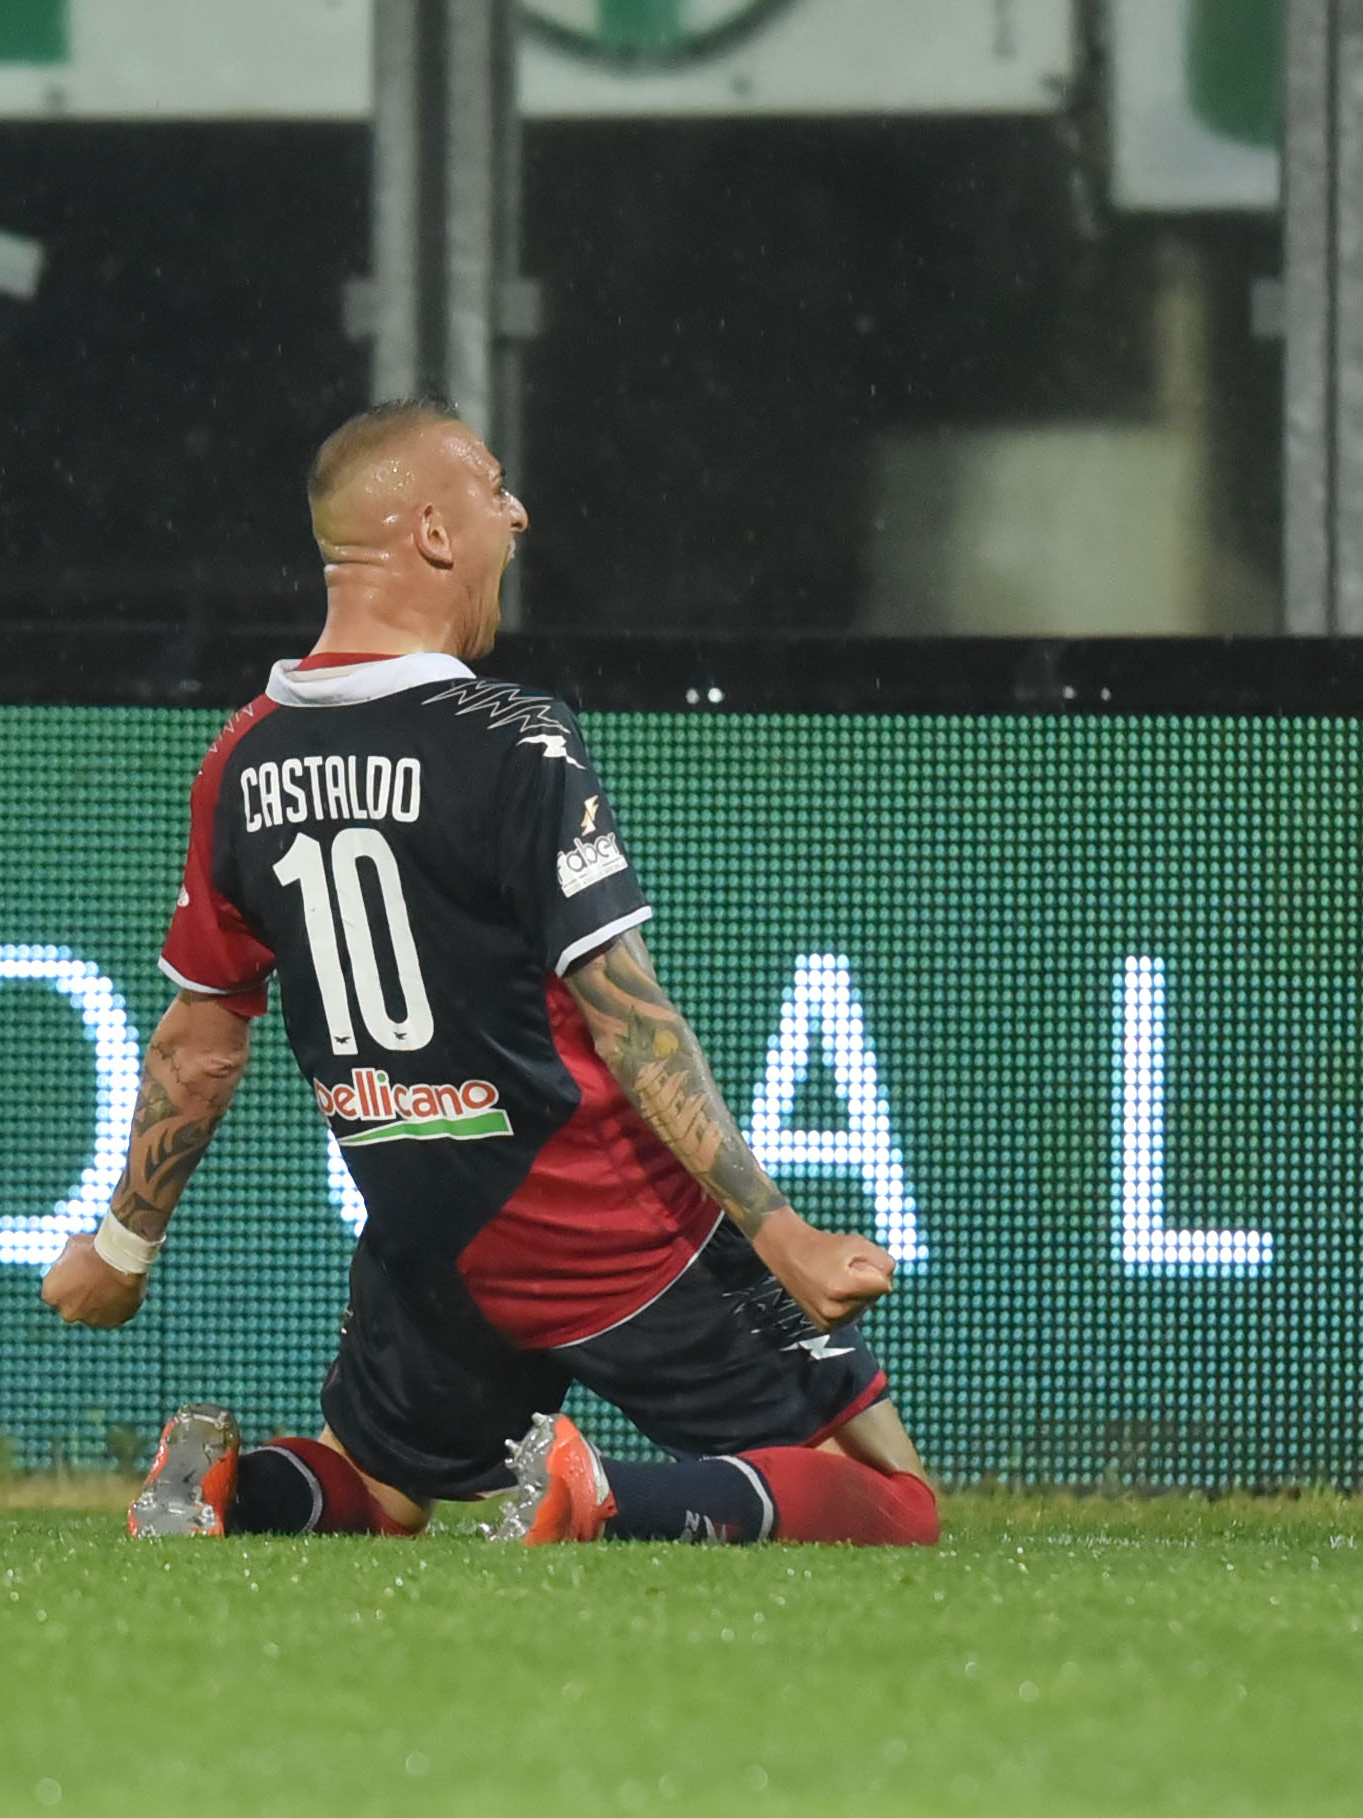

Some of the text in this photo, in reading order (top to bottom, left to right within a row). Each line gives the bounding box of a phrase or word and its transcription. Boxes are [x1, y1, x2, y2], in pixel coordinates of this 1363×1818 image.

[240, 756, 421, 831] CASTALDO
[272, 828, 434, 1056] 10
[314, 1068, 500, 1122] pellicano
